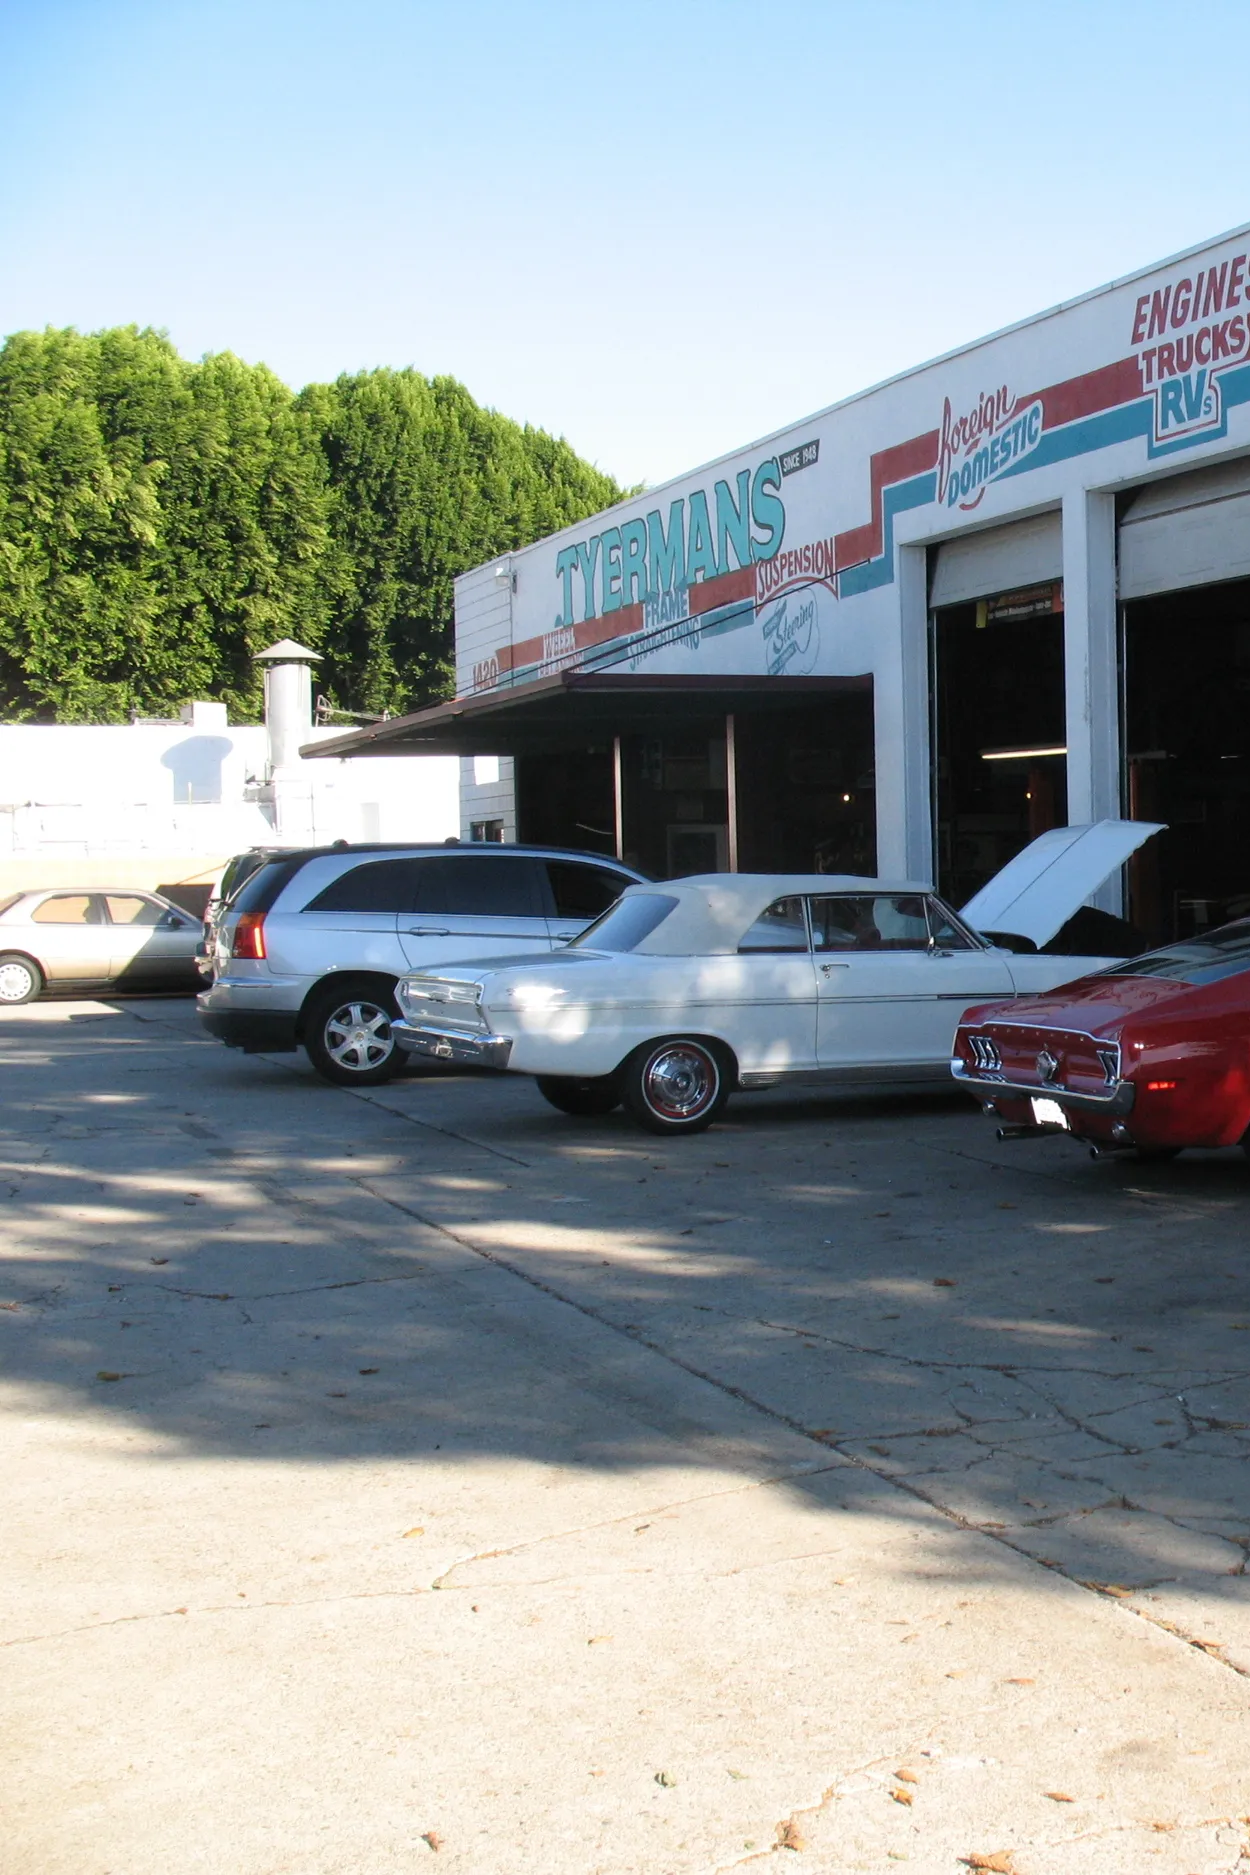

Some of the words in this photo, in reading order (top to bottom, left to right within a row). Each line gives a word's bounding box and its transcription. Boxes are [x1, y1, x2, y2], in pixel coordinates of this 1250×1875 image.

[1142, 315, 1247, 384] TRUCKS
[948, 406, 1042, 508] DOMESTIC
[555, 456, 786, 628] TYERMANS
[758, 537, 834, 601] SUSPENSION
[644, 577, 689, 629] FRAME
